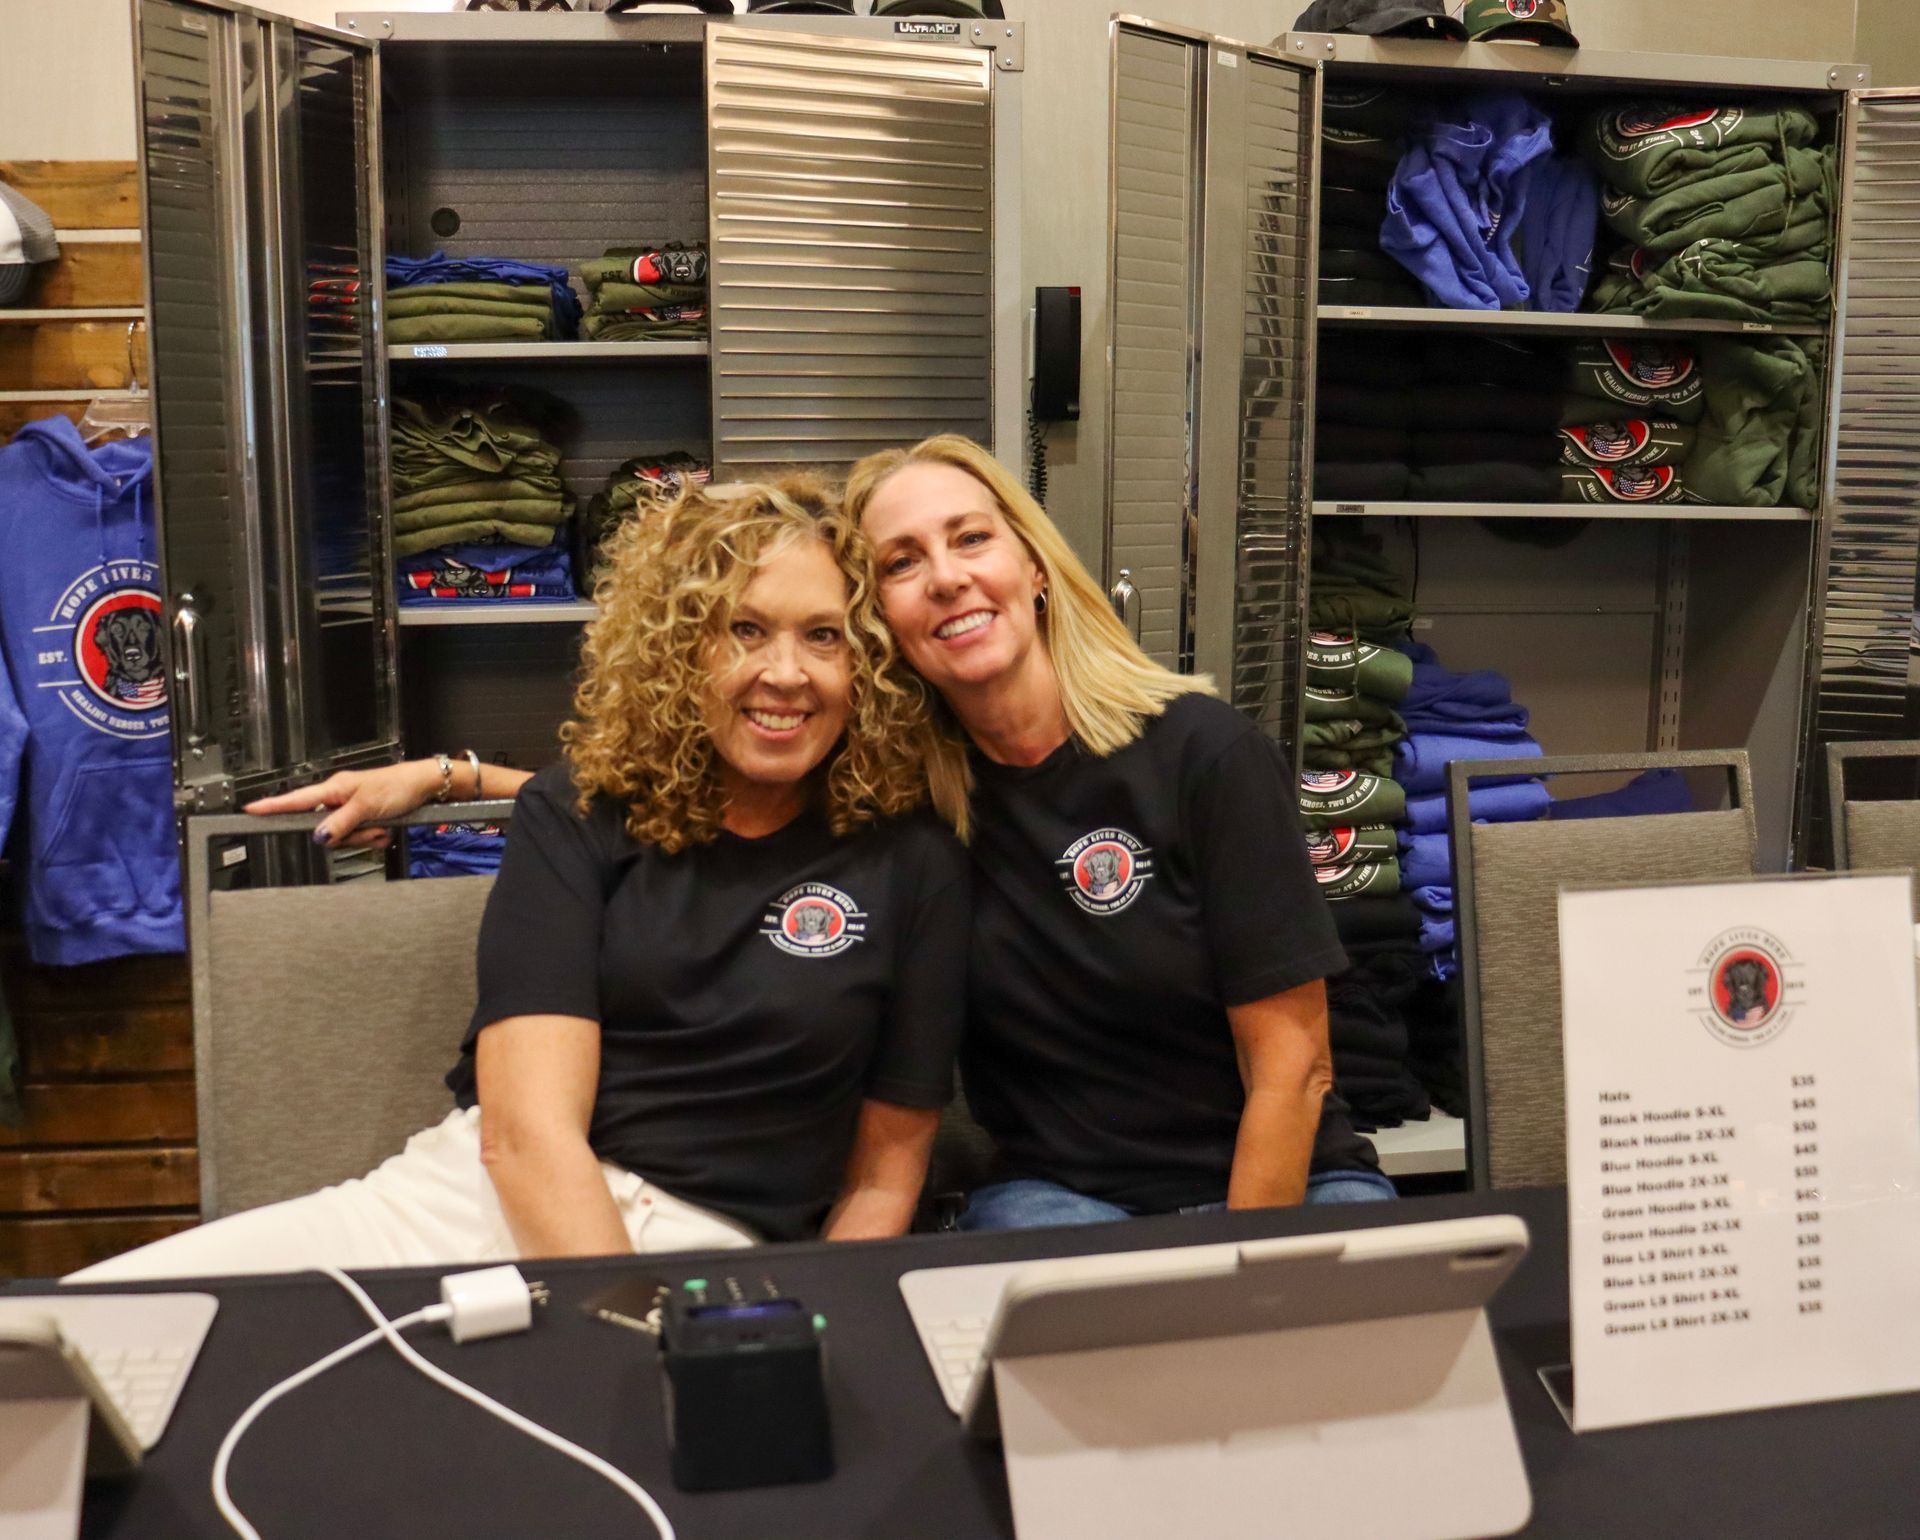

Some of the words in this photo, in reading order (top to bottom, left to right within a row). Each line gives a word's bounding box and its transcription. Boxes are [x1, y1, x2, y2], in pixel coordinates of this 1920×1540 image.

[61, 578, 99, 620] HOPE
[38, 650, 69, 665] EST.
[1322, 654, 1340, 663] TWO
[1341, 650, 1353, 661] AT
[71, 689, 108, 722] HEALING
[1328, 799, 1344, 808] TWO
[1346, 793, 1356, 802] AT
[1356, 789, 1362, 797] A
[1343, 883, 1353, 892] AT
[1599, 1091, 1631, 1103] Hats
[1600, 1113, 1638, 1127] Black
[1643, 1107, 1691, 1121] Hoodie
[1600, 1137, 1639, 1150] Black
[1643, 1131, 1692, 1145] Hoodie
[1601, 1160, 1631, 1173] Blue
[1636, 1155, 1684, 1169] Hoodie
[1601, 1184, 1632, 1197] Blue
[1637, 1178, 1685, 1192] Hoodie
[1602, 1207, 1644, 1219] Green
[1648, 1201, 1696, 1215] Hoodie
[1602, 1230, 1645, 1243] Green
[1649, 1224, 1698, 1238] Hoodie
[1602, 1253, 1634, 1266] Blue
[1661, 1246, 1694, 1260] Shirt
[1603, 1276, 1635, 1289] Blue
[1661, 1269, 1695, 1283] Shirt
[1603, 1299, 1646, 1313] Green
[1672, 1292, 1706, 1305] Shirt
[1604, 1323, 1647, 1336] Green
[1673, 1314, 1706, 1328] Shirt
